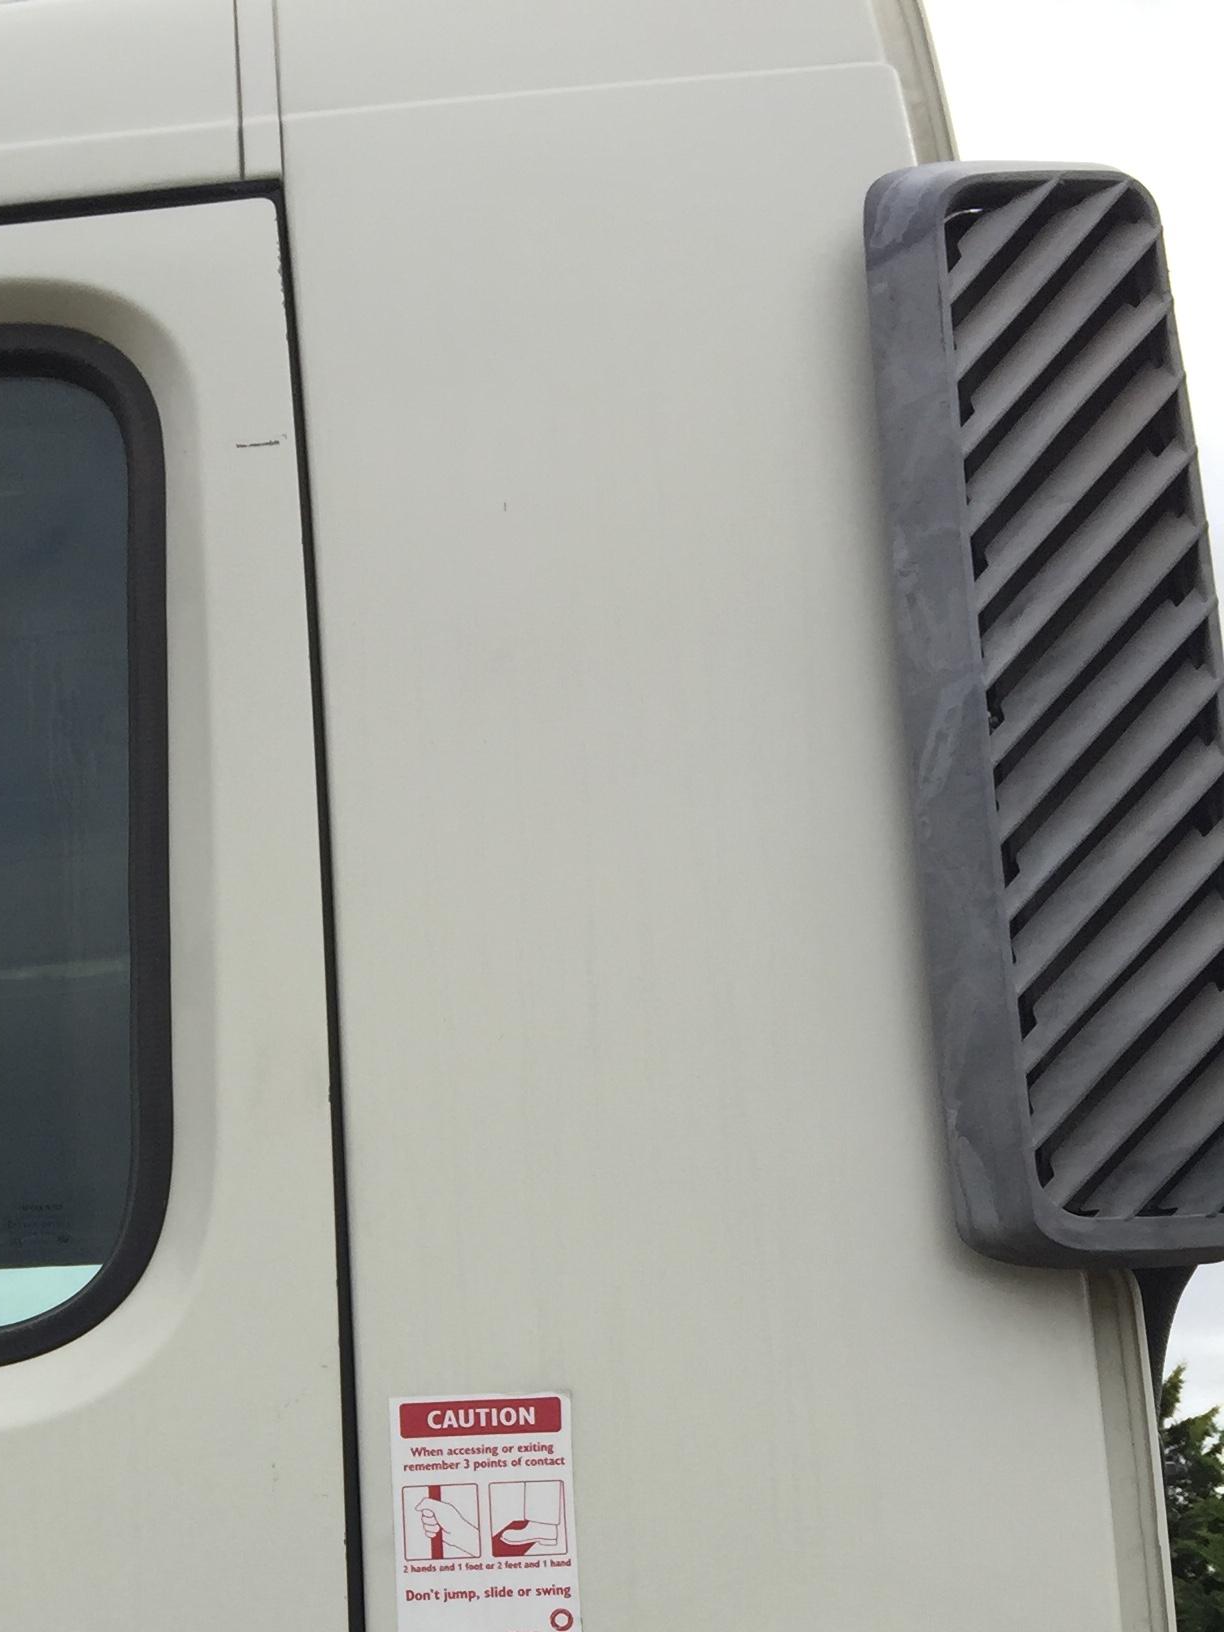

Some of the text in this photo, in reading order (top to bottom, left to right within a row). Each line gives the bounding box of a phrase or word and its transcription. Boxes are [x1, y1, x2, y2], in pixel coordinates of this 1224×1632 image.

[427, 1406, 536, 1429] CAUTION
[410, 1441, 554, 1457] When accessing or exiting
[403, 1456, 565, 1472] remember 3 points of contact
[403, 1565, 409, 1573] 2
[410, 1563, 437, 1573] hands
[439, 1563, 455, 1572] and
[465, 1562, 484, 1571] foot
[497, 1561, 502, 1570] 2
[505, 1560, 522, 1569] feet
[524, 1560, 540, 1569] and
[550, 1558, 572, 1568] hand
[405, 1584, 572, 1603] Don't jump, slide or swing
